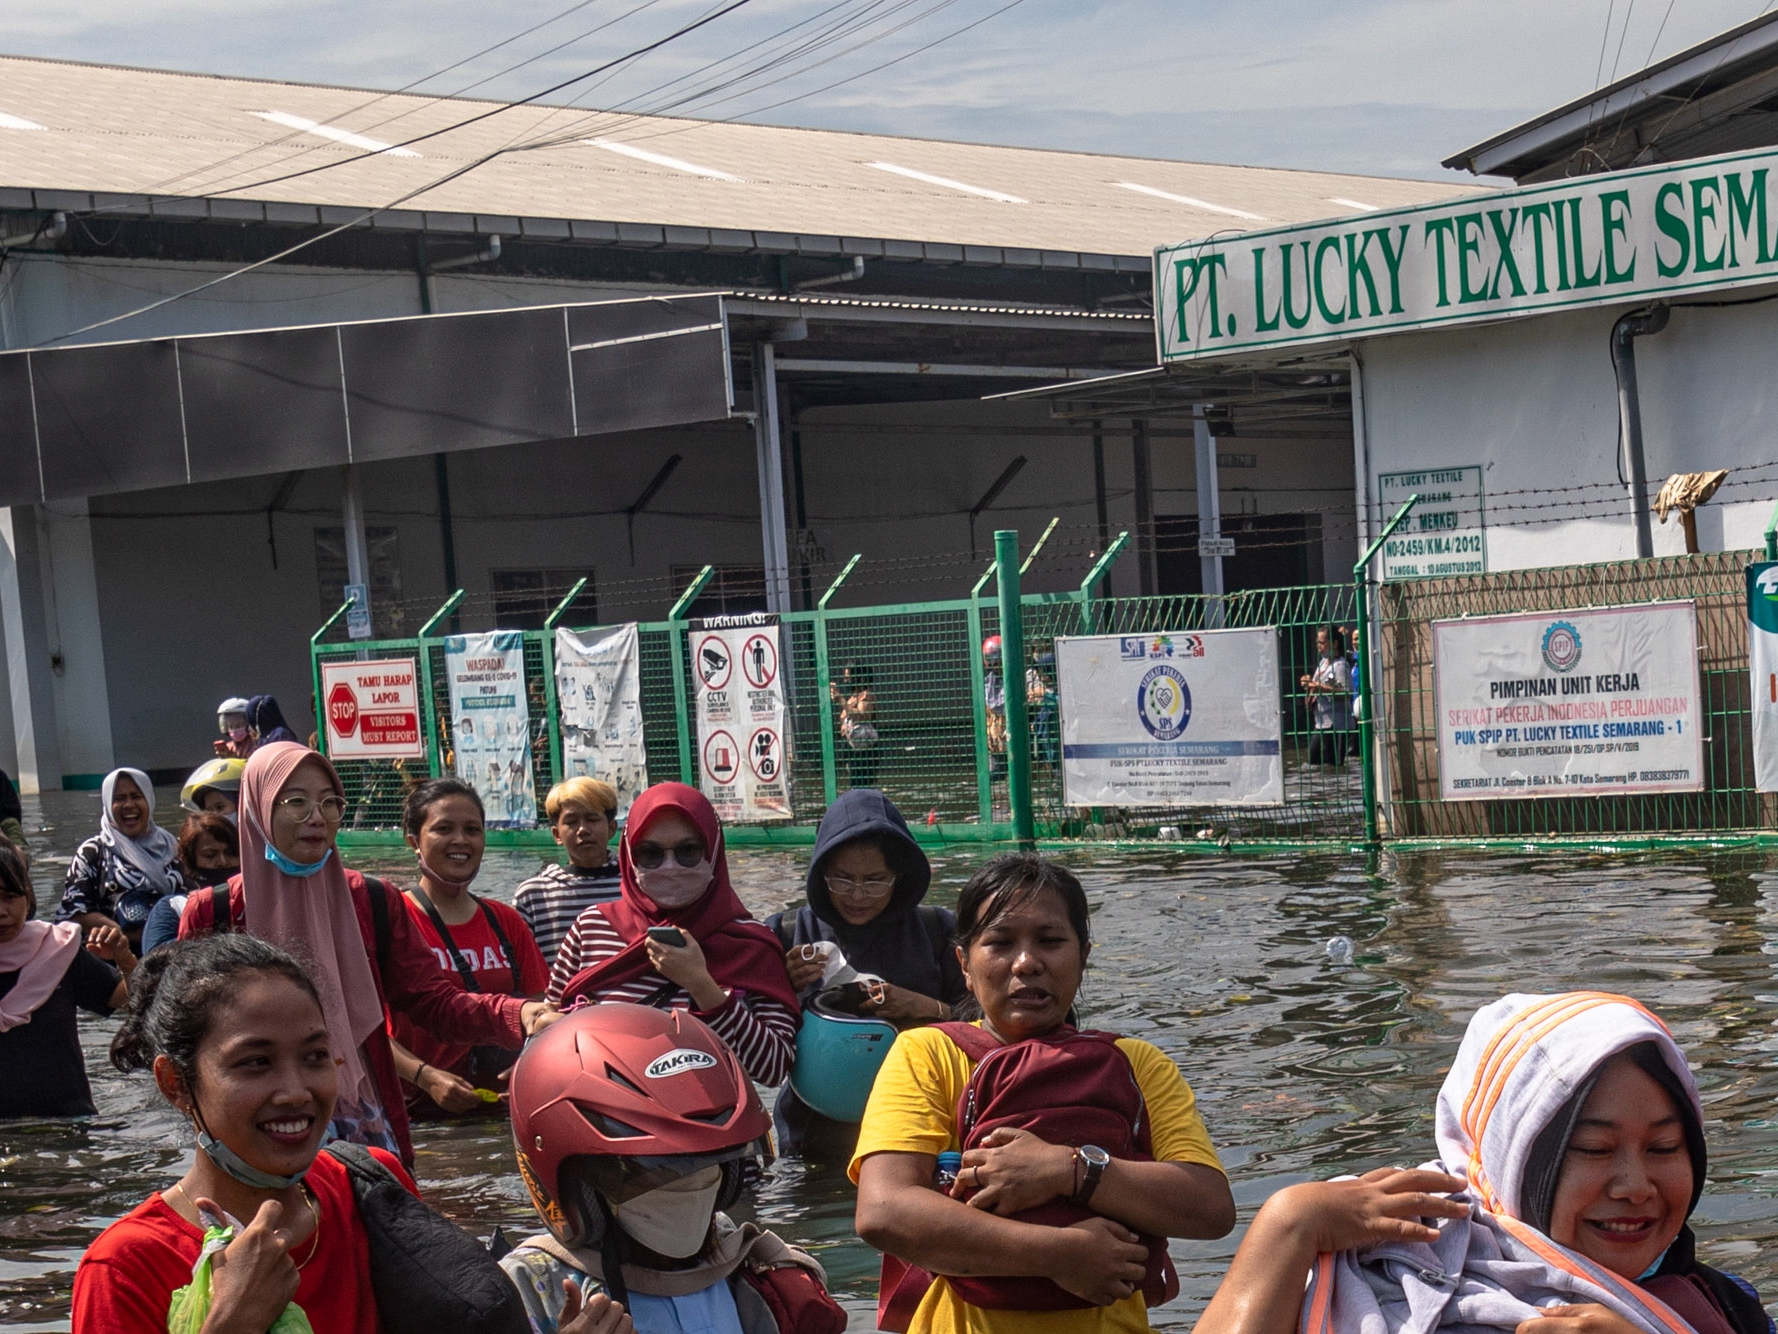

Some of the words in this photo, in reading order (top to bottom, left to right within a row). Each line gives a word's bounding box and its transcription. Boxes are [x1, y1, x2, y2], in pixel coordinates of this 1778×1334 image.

[1173, 250, 1237, 345] PT.
[1252, 224, 1411, 333] LUCKY
[1425, 190, 1637, 308] TEXTILE
[1401, 475, 1427, 487] LUCKY
[1431, 471, 1463, 484] TEXTILE
[1420, 512, 1458, 530] MENKEU
[1390, 565, 1419, 577] TANGGAL
[357, 675, 381, 688] TAMU
[383, 674, 412, 687] HARAP
[1490, 678, 1557, 699] PIMPINAN
[1561, 676, 1592, 695] UNIT
[1595, 673, 1640, 693] KERJA
[372, 692, 400, 704] LAPOR
[707, 691, 727, 702] CCTV
[332, 702, 355, 720] STOP
[1448, 707, 1492, 727] SERIKAT
[1495, 705, 1544, 724] PEKERJA
[1547, 701, 1608, 722] INDONESIA
[1610, 697, 1688, 718] PERJUANGAN
[370, 715, 407, 727] VISITORS
[362, 731, 384, 742] MUST
[385, 730, 416, 741] REPORT
[1455, 730, 1476, 745] PUK
[1478, 729, 1502, 744] SPIP
[1505, 727, 1521, 742] PT.
[1523, 726, 1557, 742] LUCKY
[1559, 724, 1600, 740] TEXTILE
[1602, 720, 1665, 738] SEMARANG
